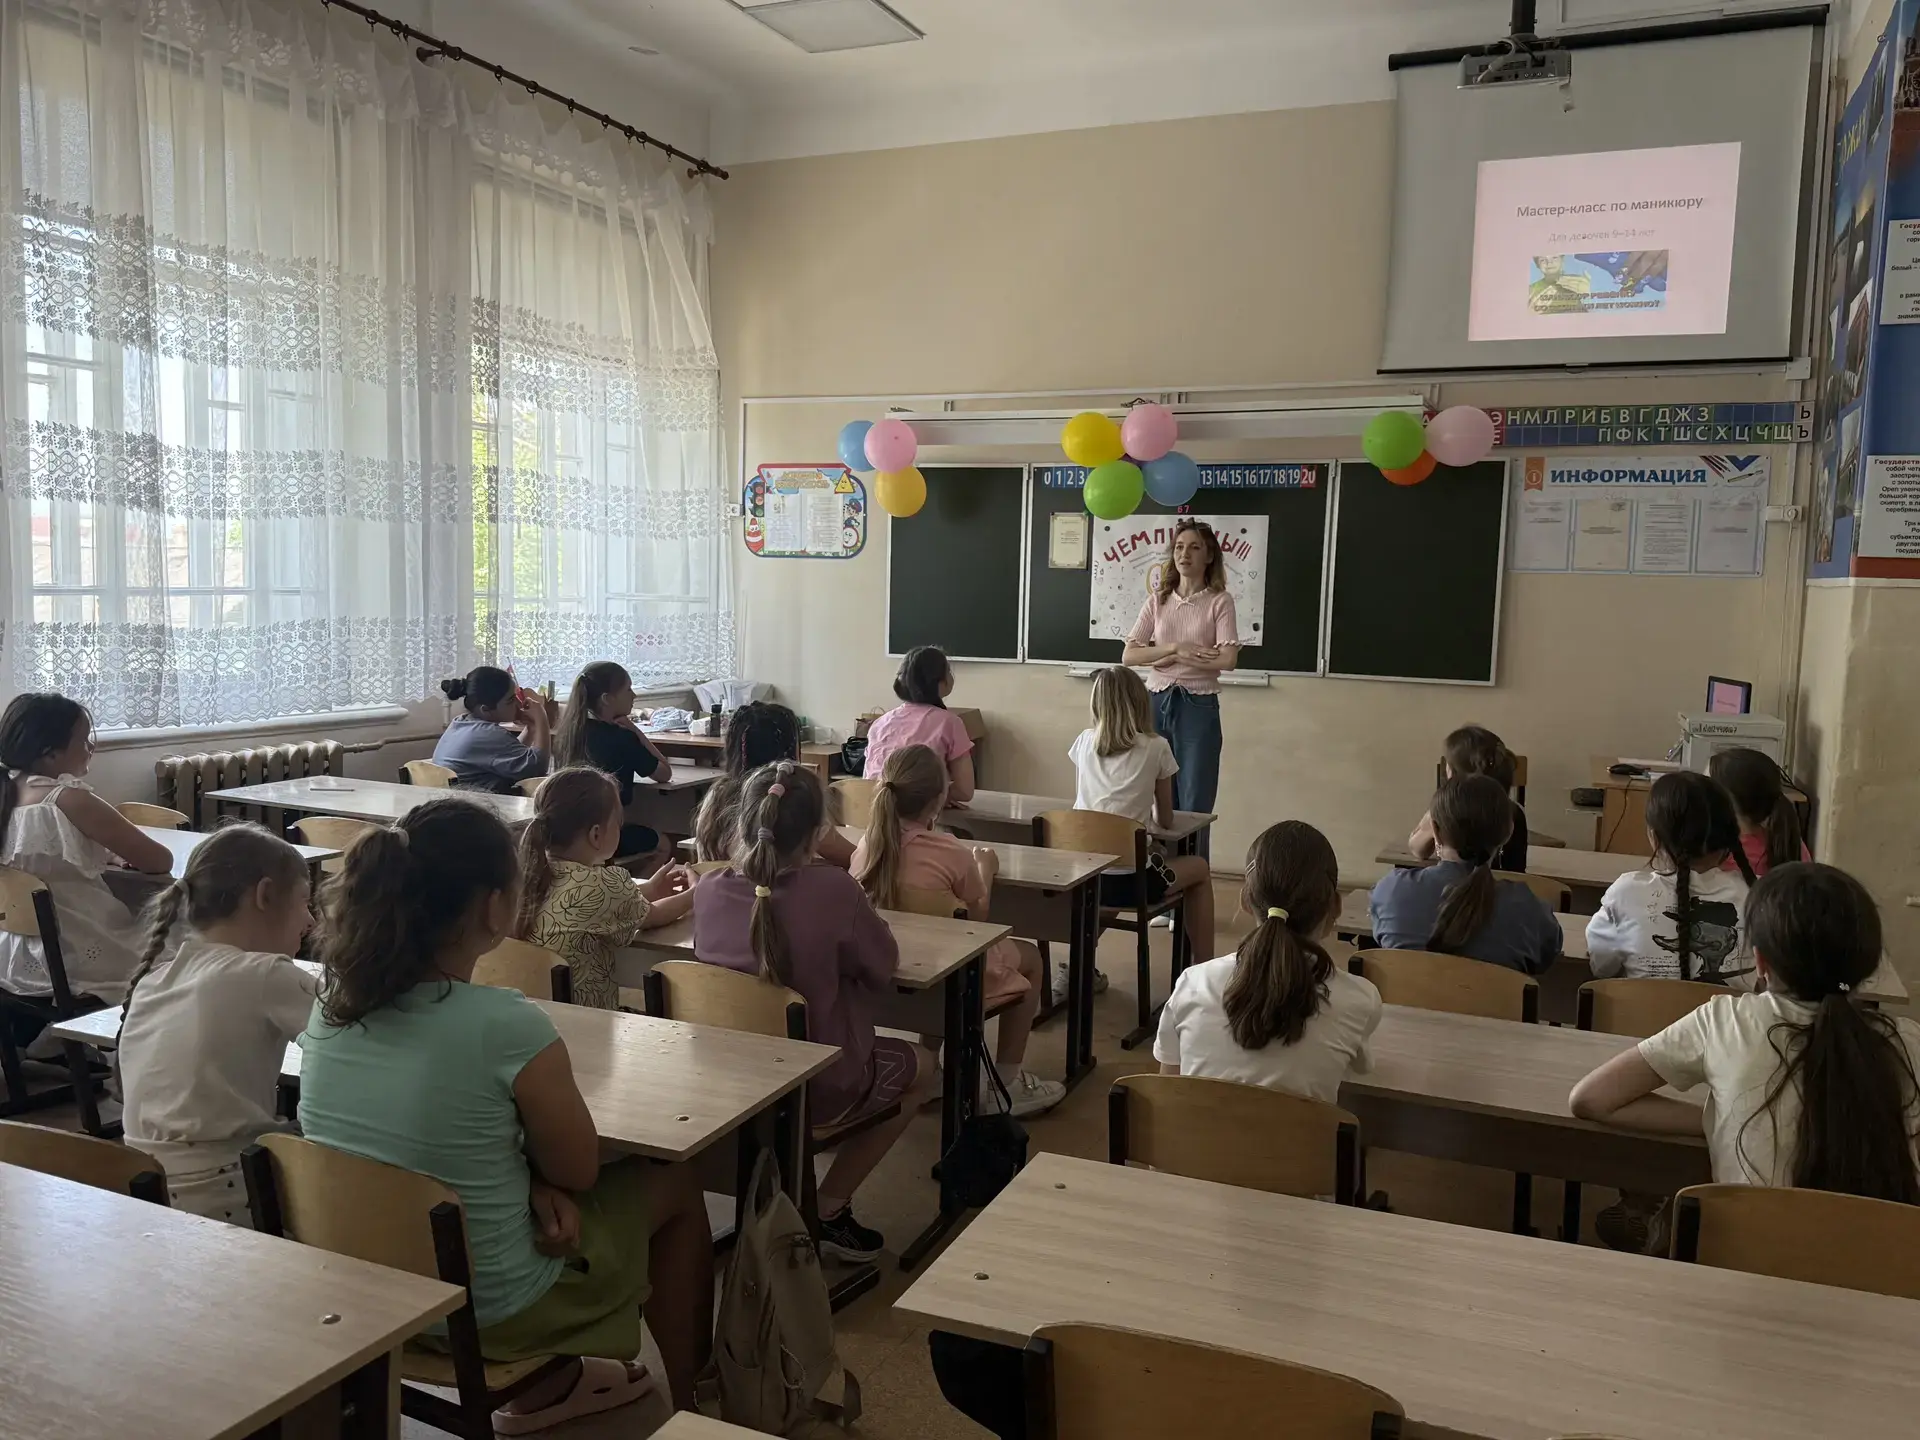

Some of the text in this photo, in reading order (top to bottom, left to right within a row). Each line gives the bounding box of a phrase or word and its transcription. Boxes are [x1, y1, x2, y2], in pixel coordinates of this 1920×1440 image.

[1516, 197, 1703, 218] Мастер-класс по маникюру
[1044, 468, 1316, 485] 0 1 2 3 13 14 15 16 17 18 19 20
[1550, 469, 1707, 486] ИНФОРМАЦИЯ
